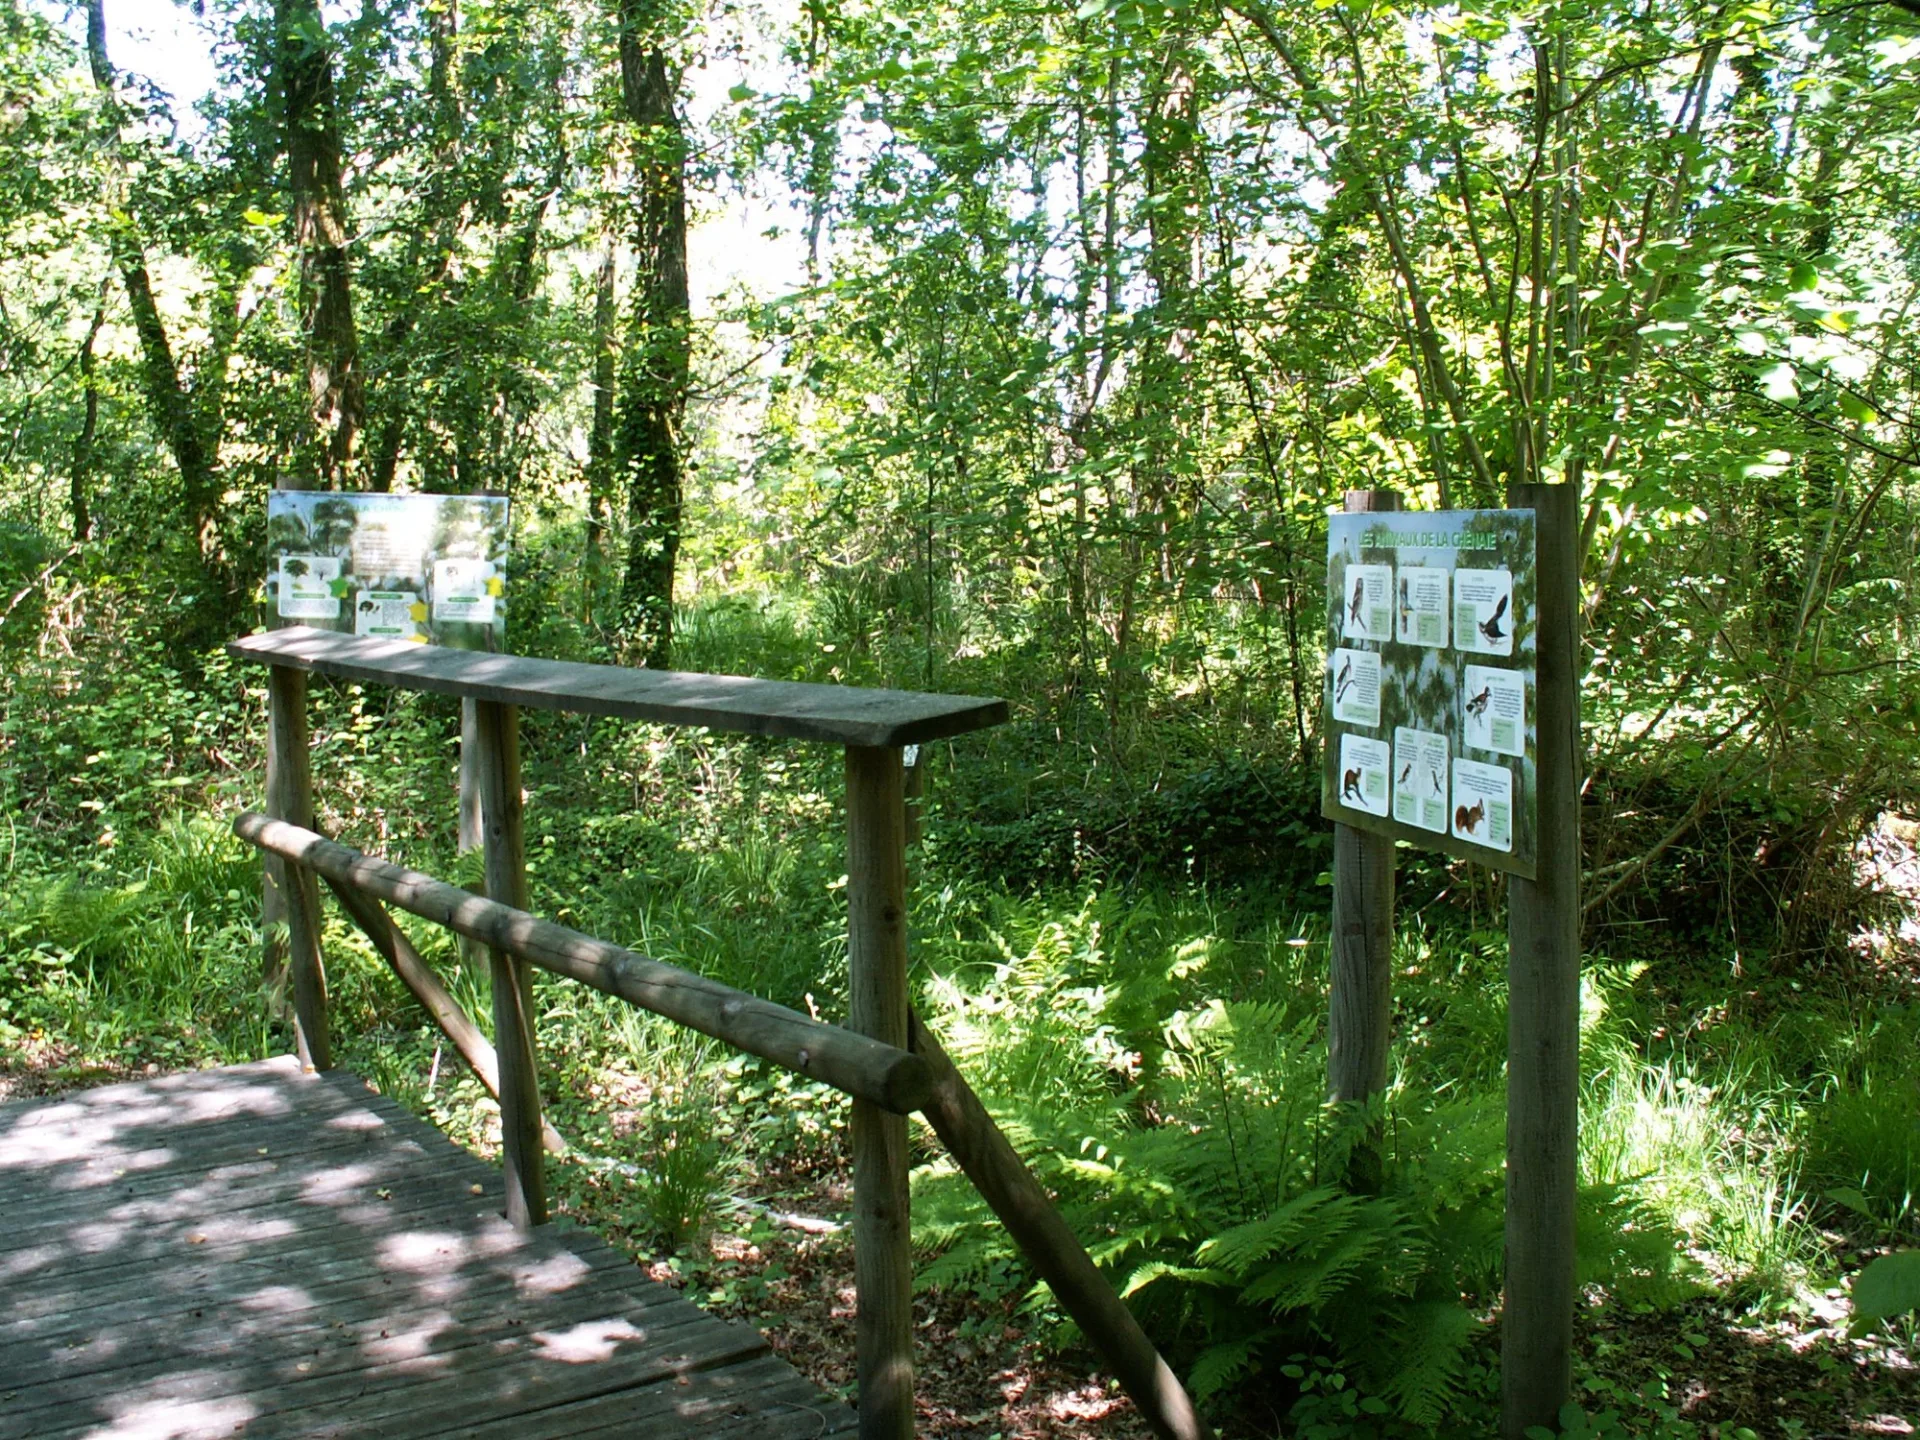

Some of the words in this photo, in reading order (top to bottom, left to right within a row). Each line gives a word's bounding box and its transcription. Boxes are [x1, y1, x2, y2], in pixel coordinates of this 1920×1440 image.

[1359, 531, 1374, 548] LES
[1375, 531, 1419, 549] ANIMAUX
[1421, 532, 1435, 548] DE
[1437, 532, 1450, 548] LA
[1452, 530, 1497, 550] CHÊNAIE
